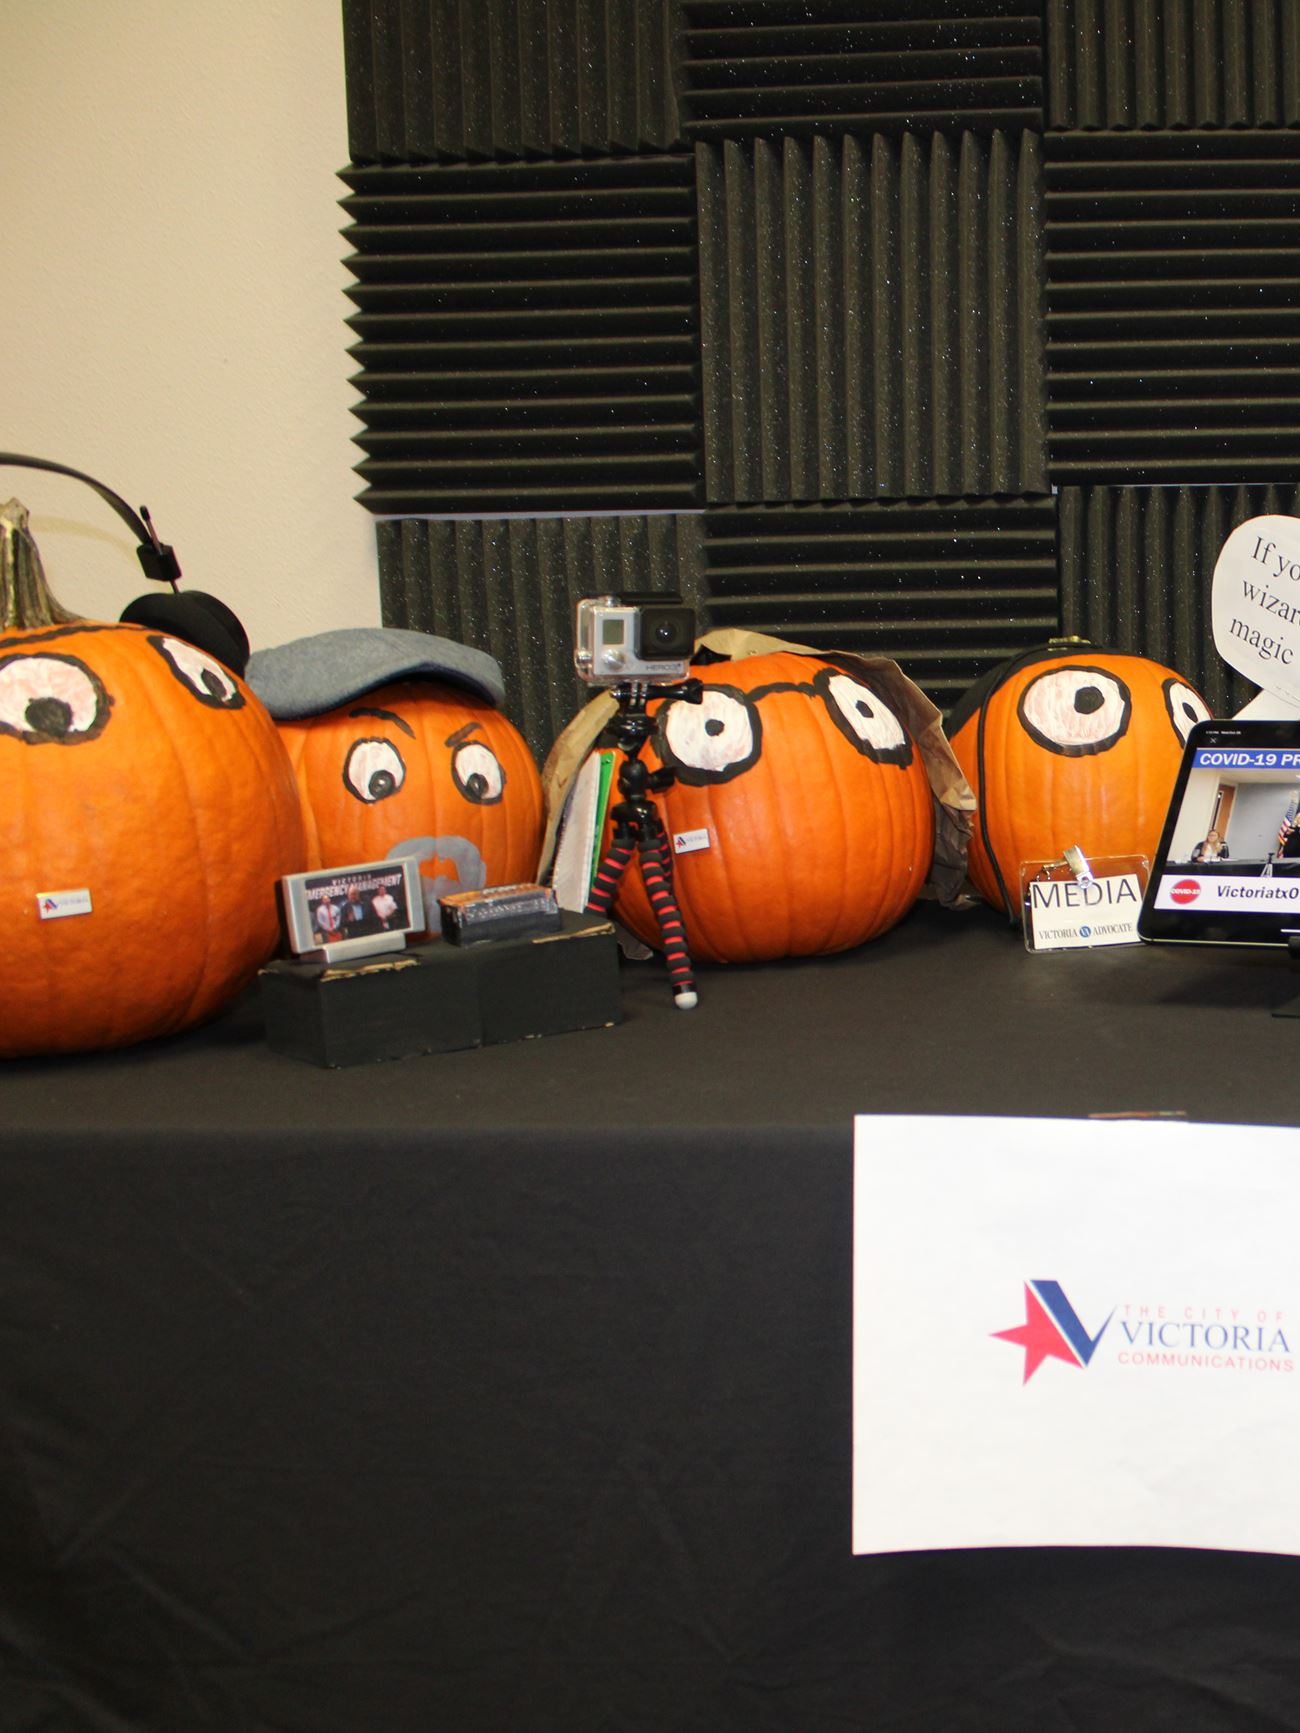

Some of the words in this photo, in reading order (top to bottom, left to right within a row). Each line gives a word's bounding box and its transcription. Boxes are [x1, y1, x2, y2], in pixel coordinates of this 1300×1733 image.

[1251, 535, 1277, 564] If
[1228, 618, 1294, 664] magic
[1199, 753, 1277, 766] COVID-19
[1032, 878, 1138, 909] MEDIA
[1038, 928, 1078, 940] VICTORIA
[1093, 923, 1133, 936] ADVOCATE
[1123, 1304, 1167, 1318] THE
[1184, 1306, 1240, 1321] CITY
[1256, 1310, 1284, 1323] OF
[1120, 1320, 1291, 1353] VICTORIA
[1117, 1351, 1295, 1373] COMMUNICATIONS
